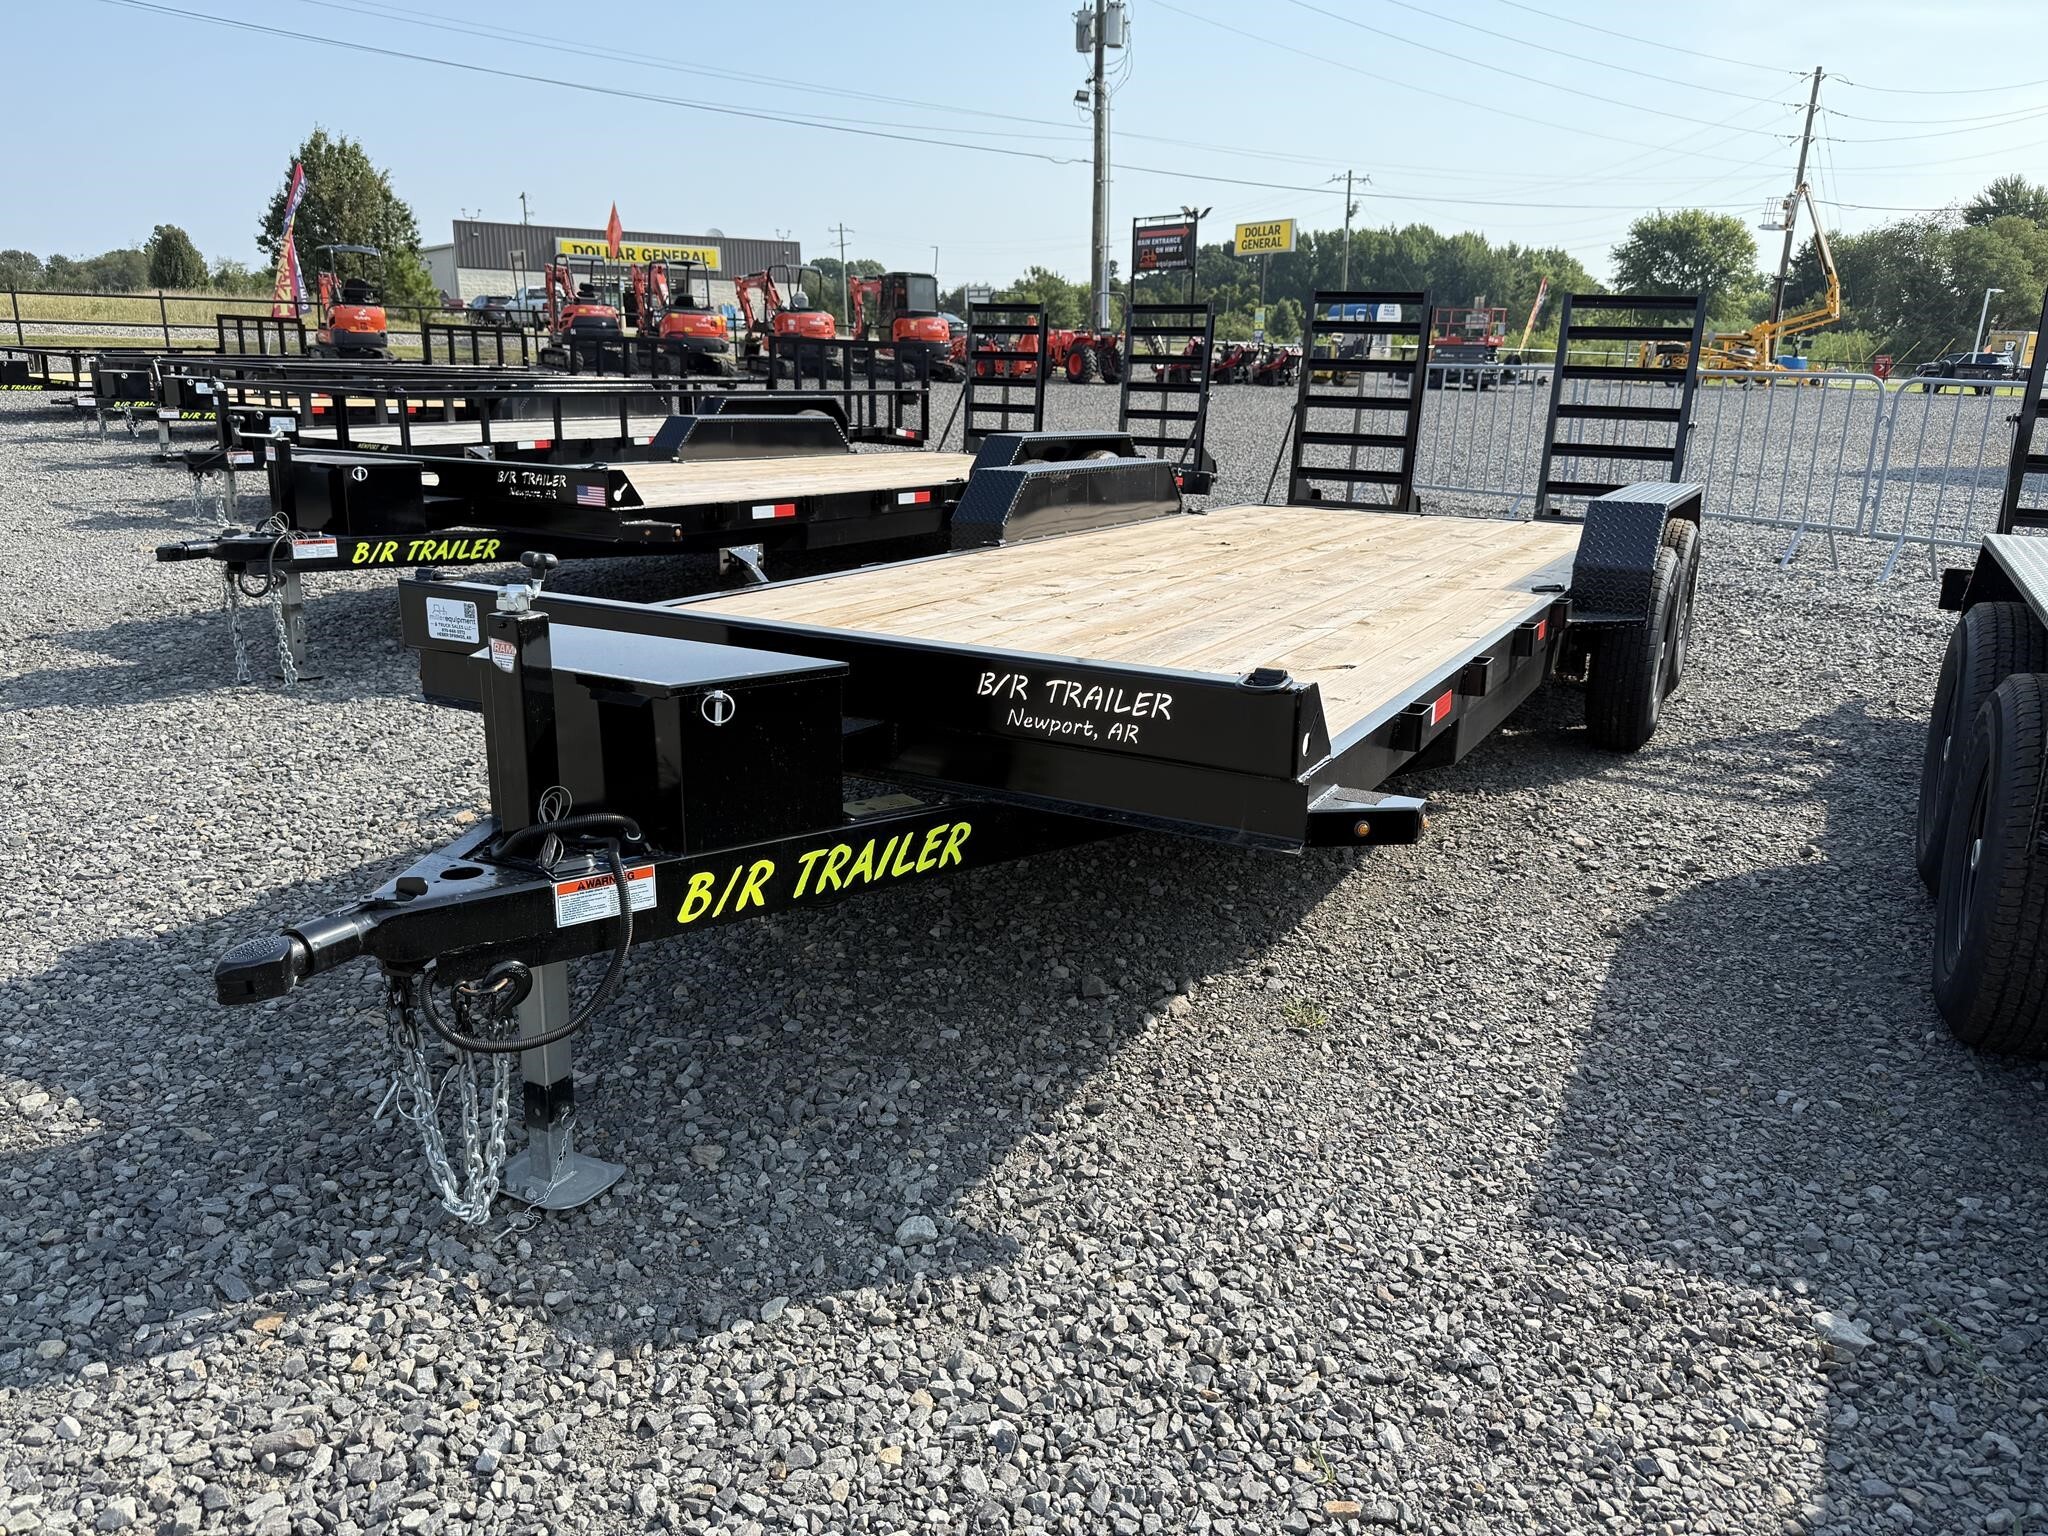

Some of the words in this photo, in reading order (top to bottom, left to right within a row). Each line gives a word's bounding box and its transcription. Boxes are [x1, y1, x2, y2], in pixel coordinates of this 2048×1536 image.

[1244, 224, 1281, 238] DOLLAR
[1151, 237, 1181, 246] ENTRANCE
[1241, 237, 1282, 250] GENERAL
[181, 411, 201, 419] B/R
[497, 470, 517, 483] B/R
[522, 471, 567, 487] TRAILER
[352, 540, 399, 564] B/R
[407, 538, 501, 562] TRAILER
[976, 671, 1029, 701] B/R
[1045, 679, 1173, 721] TRAILER
[1006, 707, 1098, 742] Newport,
[1107, 722, 1139, 744] AR
[586, 871, 635, 888] WARNG
[677, 859, 775, 924] B/R
[792, 821, 972, 899] TRAILER
